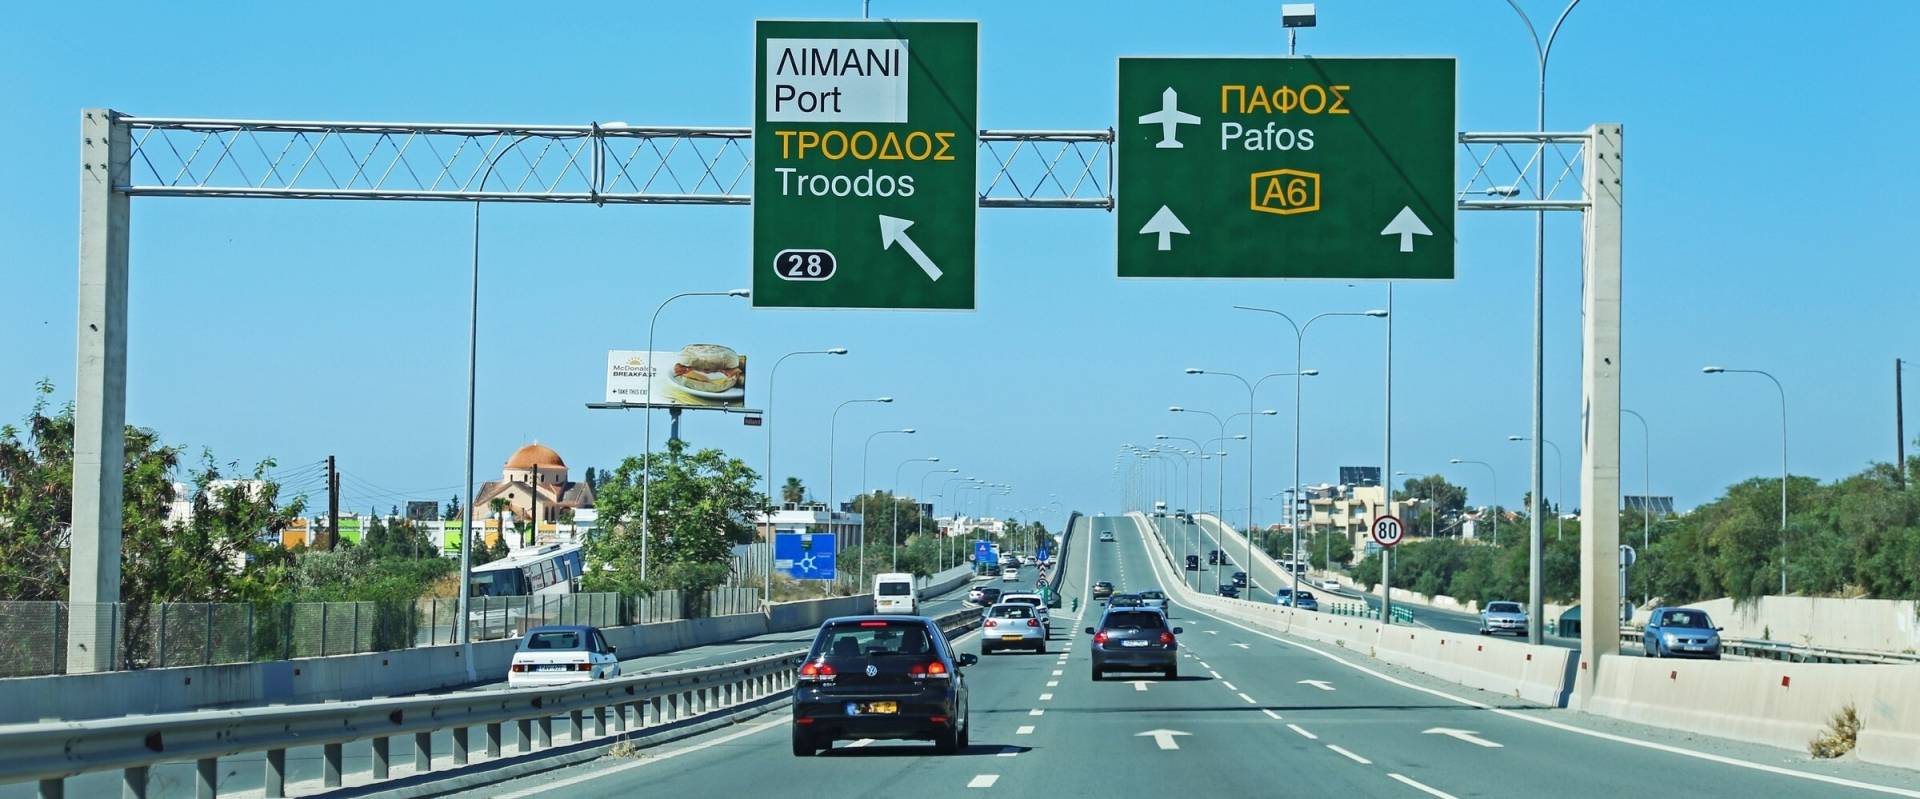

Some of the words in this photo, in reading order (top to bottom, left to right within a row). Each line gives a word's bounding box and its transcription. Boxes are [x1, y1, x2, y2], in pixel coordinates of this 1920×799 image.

[776, 47, 899, 76] ΛΙΜΑΝΙ
[775, 84, 841, 113] Port
[1221, 84, 1350, 114] ΠΑΦΟΣ
[775, 130, 955, 161] ΤΡΟΟΔΟΣ
[1221, 121, 1314, 151] Pafos
[775, 168, 915, 197] Troodos
[1262, 177, 1307, 207] A6
[788, 254, 822, 277] 28
[1379, 522, 1397, 539] 80
